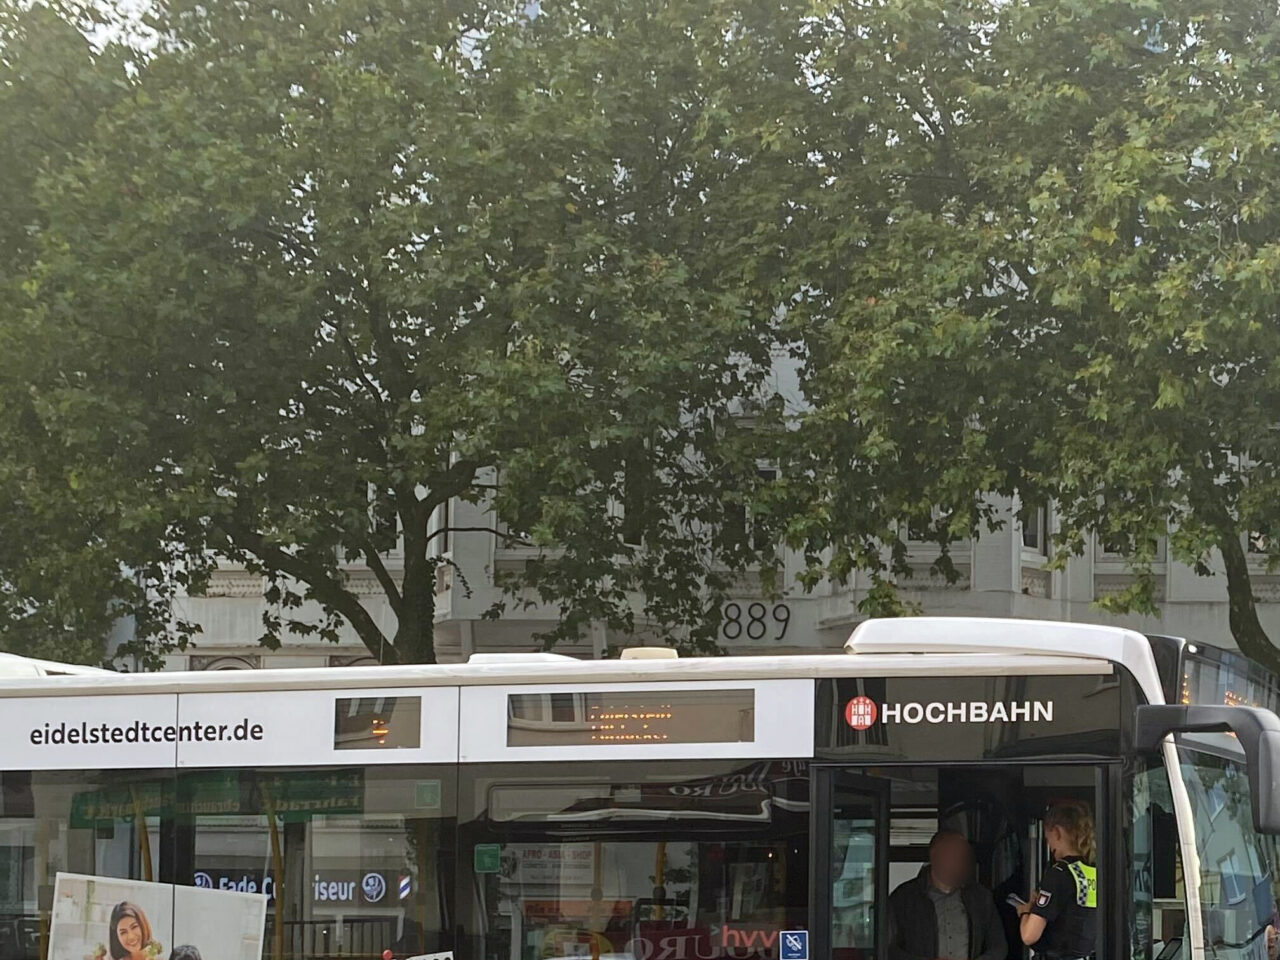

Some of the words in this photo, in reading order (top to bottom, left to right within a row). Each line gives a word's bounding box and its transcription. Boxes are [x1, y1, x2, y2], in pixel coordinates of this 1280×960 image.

[881, 700, 1054, 725] HOCHBAHN
[30, 717, 264, 745] eidelstedtcenter.de
[313, 873, 357, 901] iseur
